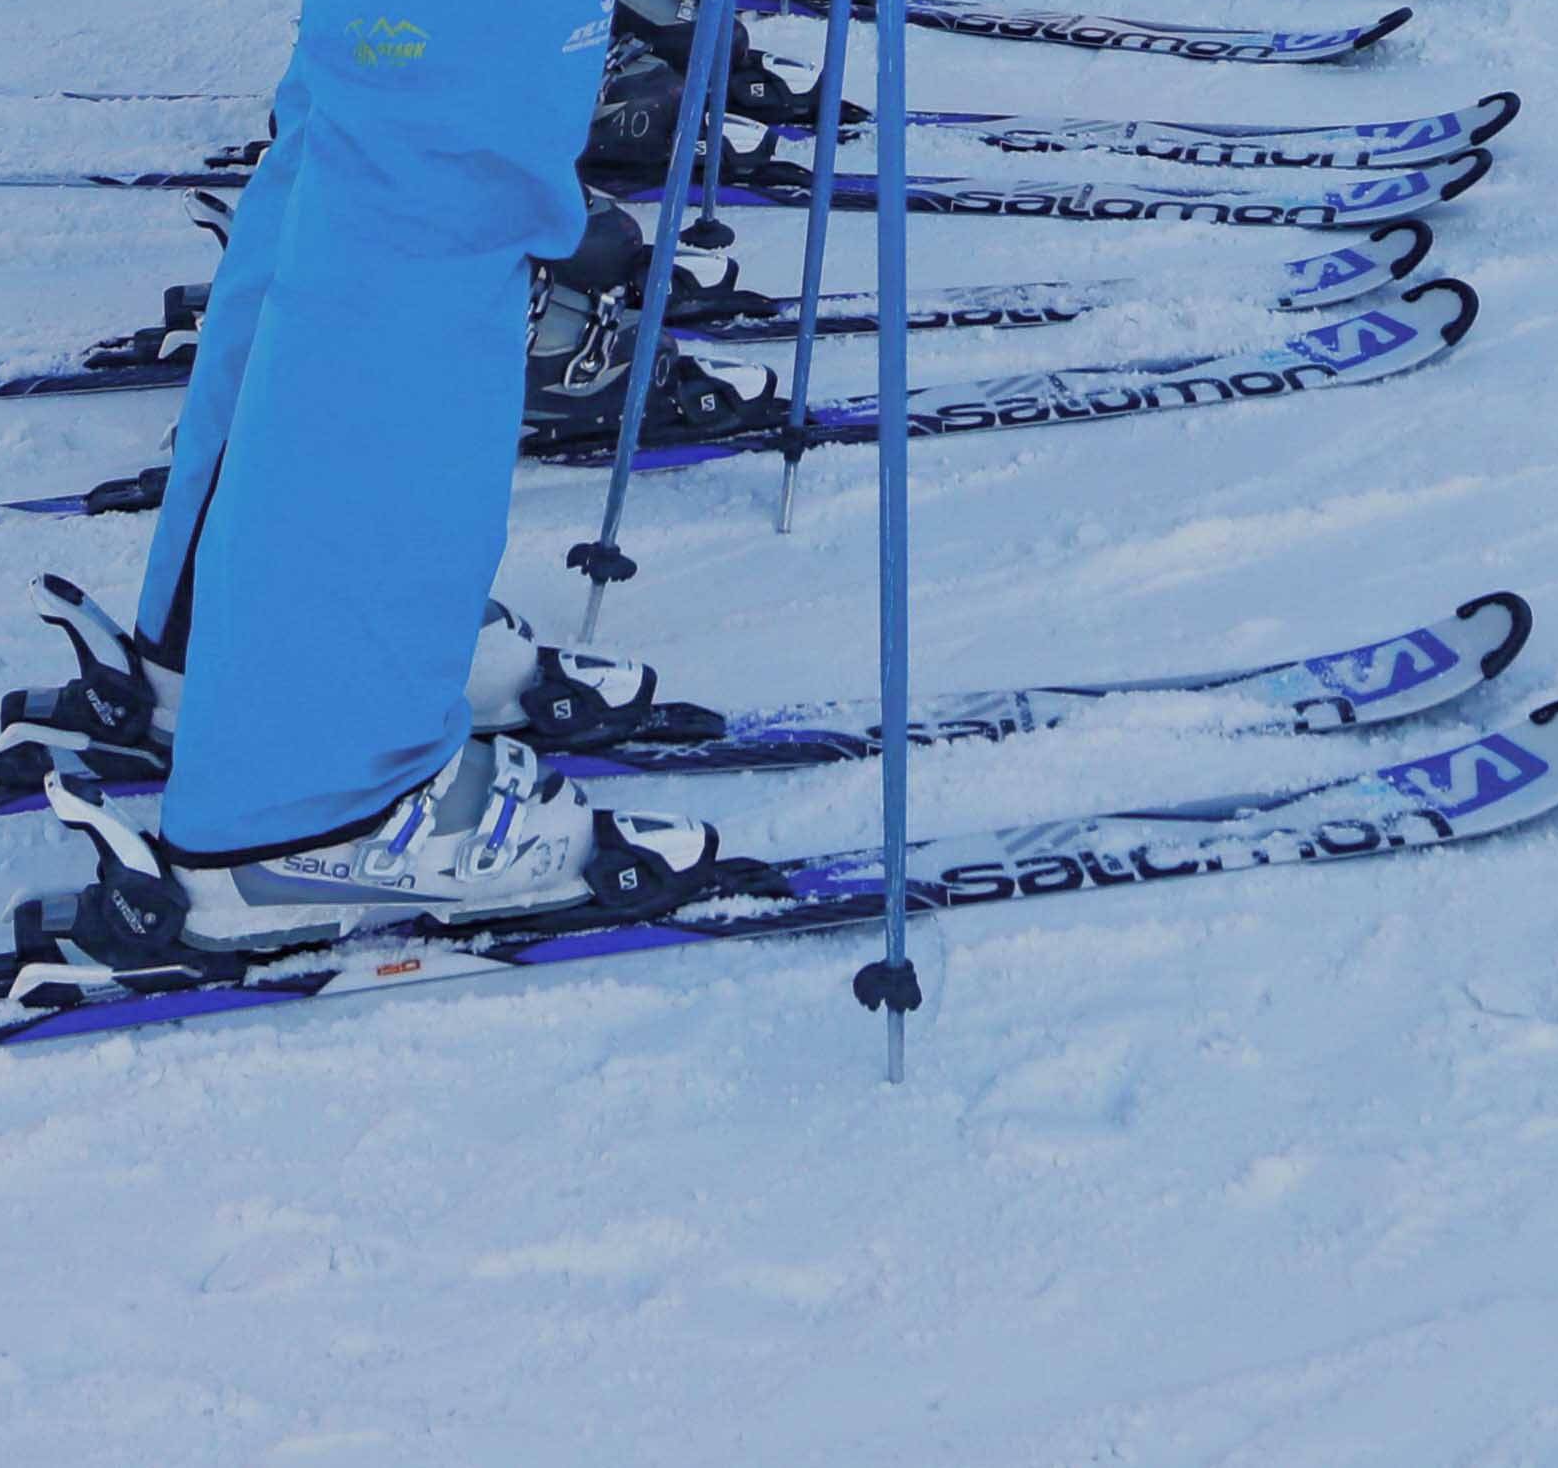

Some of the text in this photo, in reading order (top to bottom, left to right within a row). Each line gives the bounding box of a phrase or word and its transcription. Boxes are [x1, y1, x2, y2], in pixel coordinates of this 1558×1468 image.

[953, 11, 1279, 60] salomon
[949, 182, 1339, 227] salomon
[939, 364, 1340, 428] salomon
